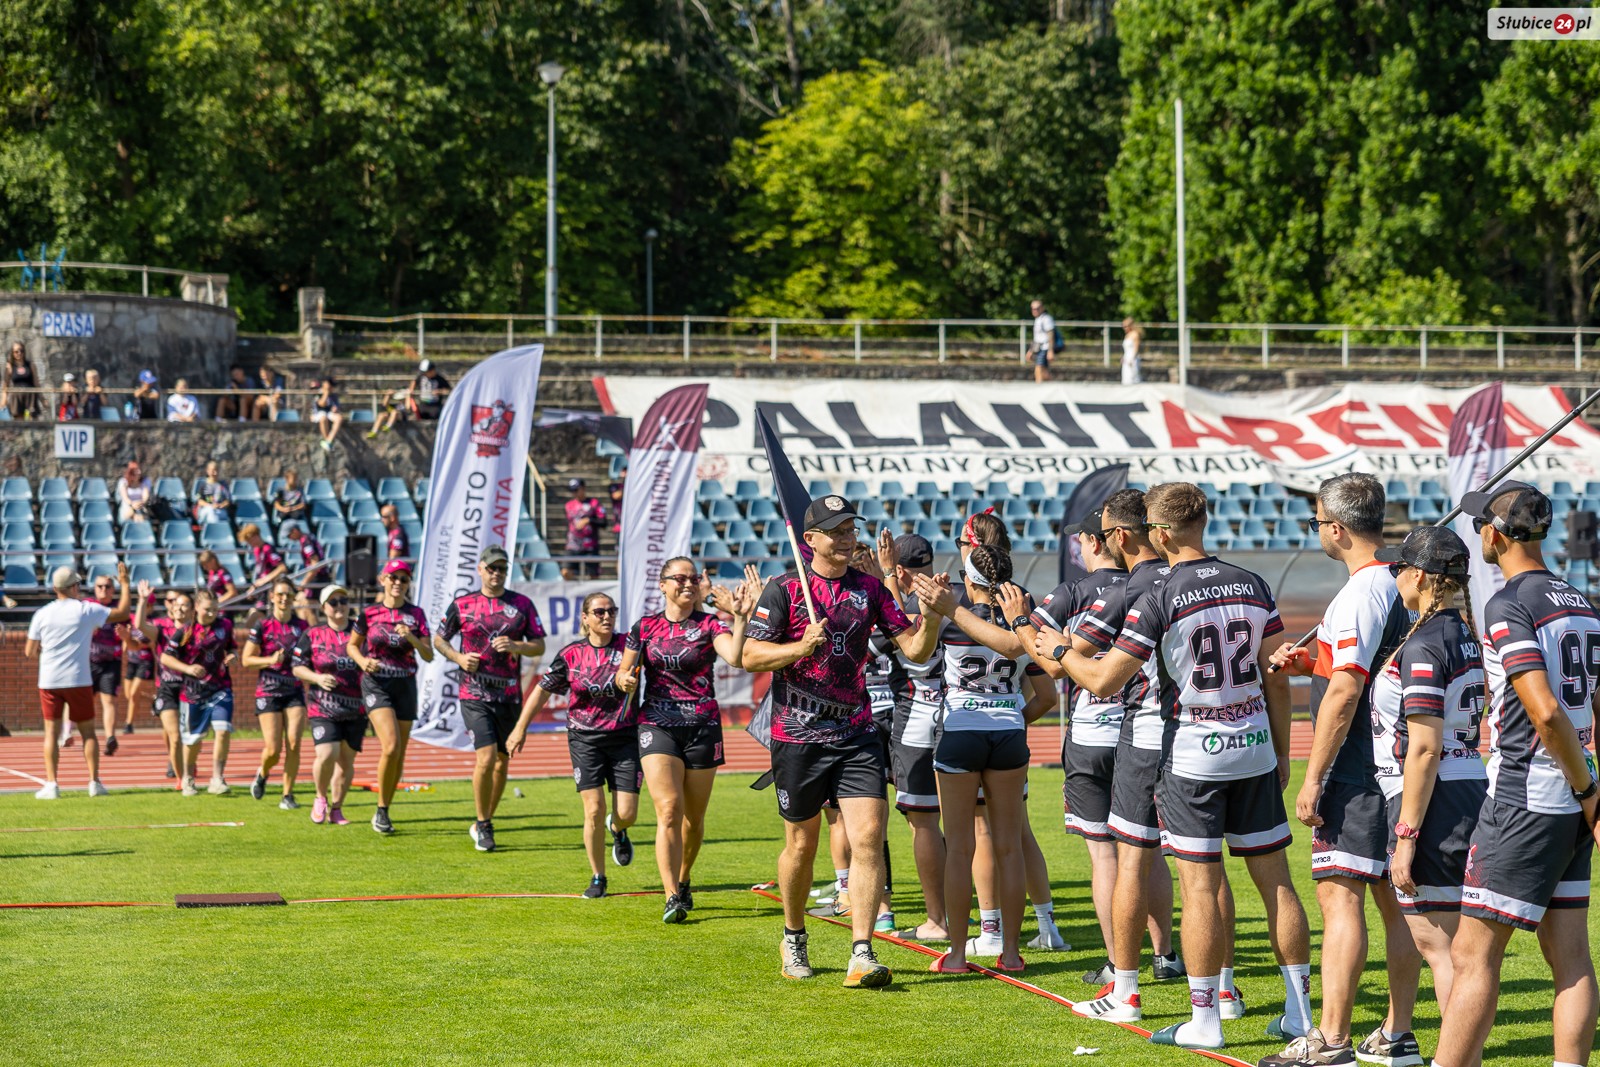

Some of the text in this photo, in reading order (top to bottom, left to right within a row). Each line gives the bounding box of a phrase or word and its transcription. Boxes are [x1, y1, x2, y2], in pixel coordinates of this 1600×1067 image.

[43, 313, 95, 337] PRASA
[61, 431, 88, 453] VIP
[747, 454, 969, 473] CNTRALNY
[647, 459, 672, 554] PALANTOWA
[1172, 583, 1254, 609] BIAŁKOWSKI
[832, 632, 846, 656] 3
[1189, 617, 1259, 693] 92
[663, 654, 681, 671] 11
[959, 654, 1018, 694] 23
[1190, 694, 1264, 723] RZESZÓW
[1226, 729, 1269, 750] ALPAR
